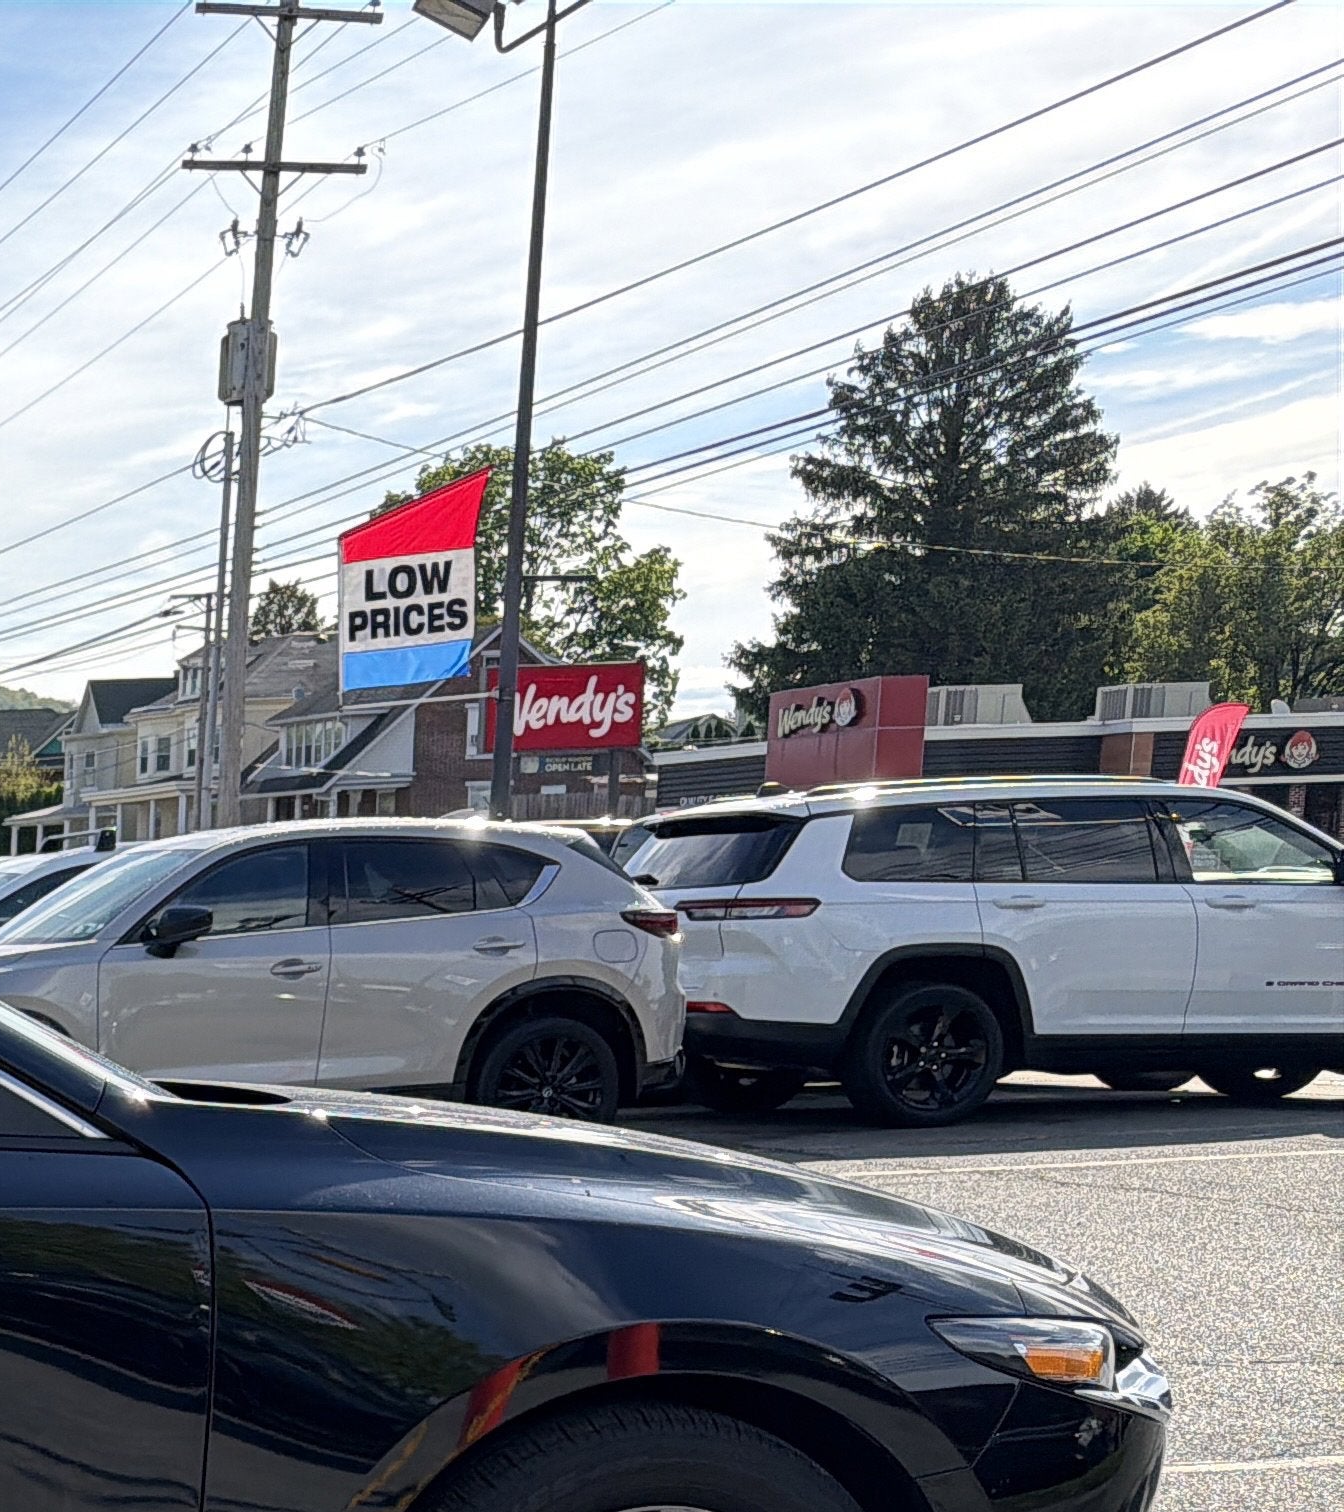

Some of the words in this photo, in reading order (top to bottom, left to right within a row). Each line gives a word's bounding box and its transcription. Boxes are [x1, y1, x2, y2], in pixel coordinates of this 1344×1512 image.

[364, 559, 453, 602] LOW
[348, 597, 468, 642] PRICES
[777, 695, 832, 738] Wendy's
[544, 763, 570, 773] OPEN
[571, 761, 593, 771] LATE
[1184, 737, 1220, 787] dy's
